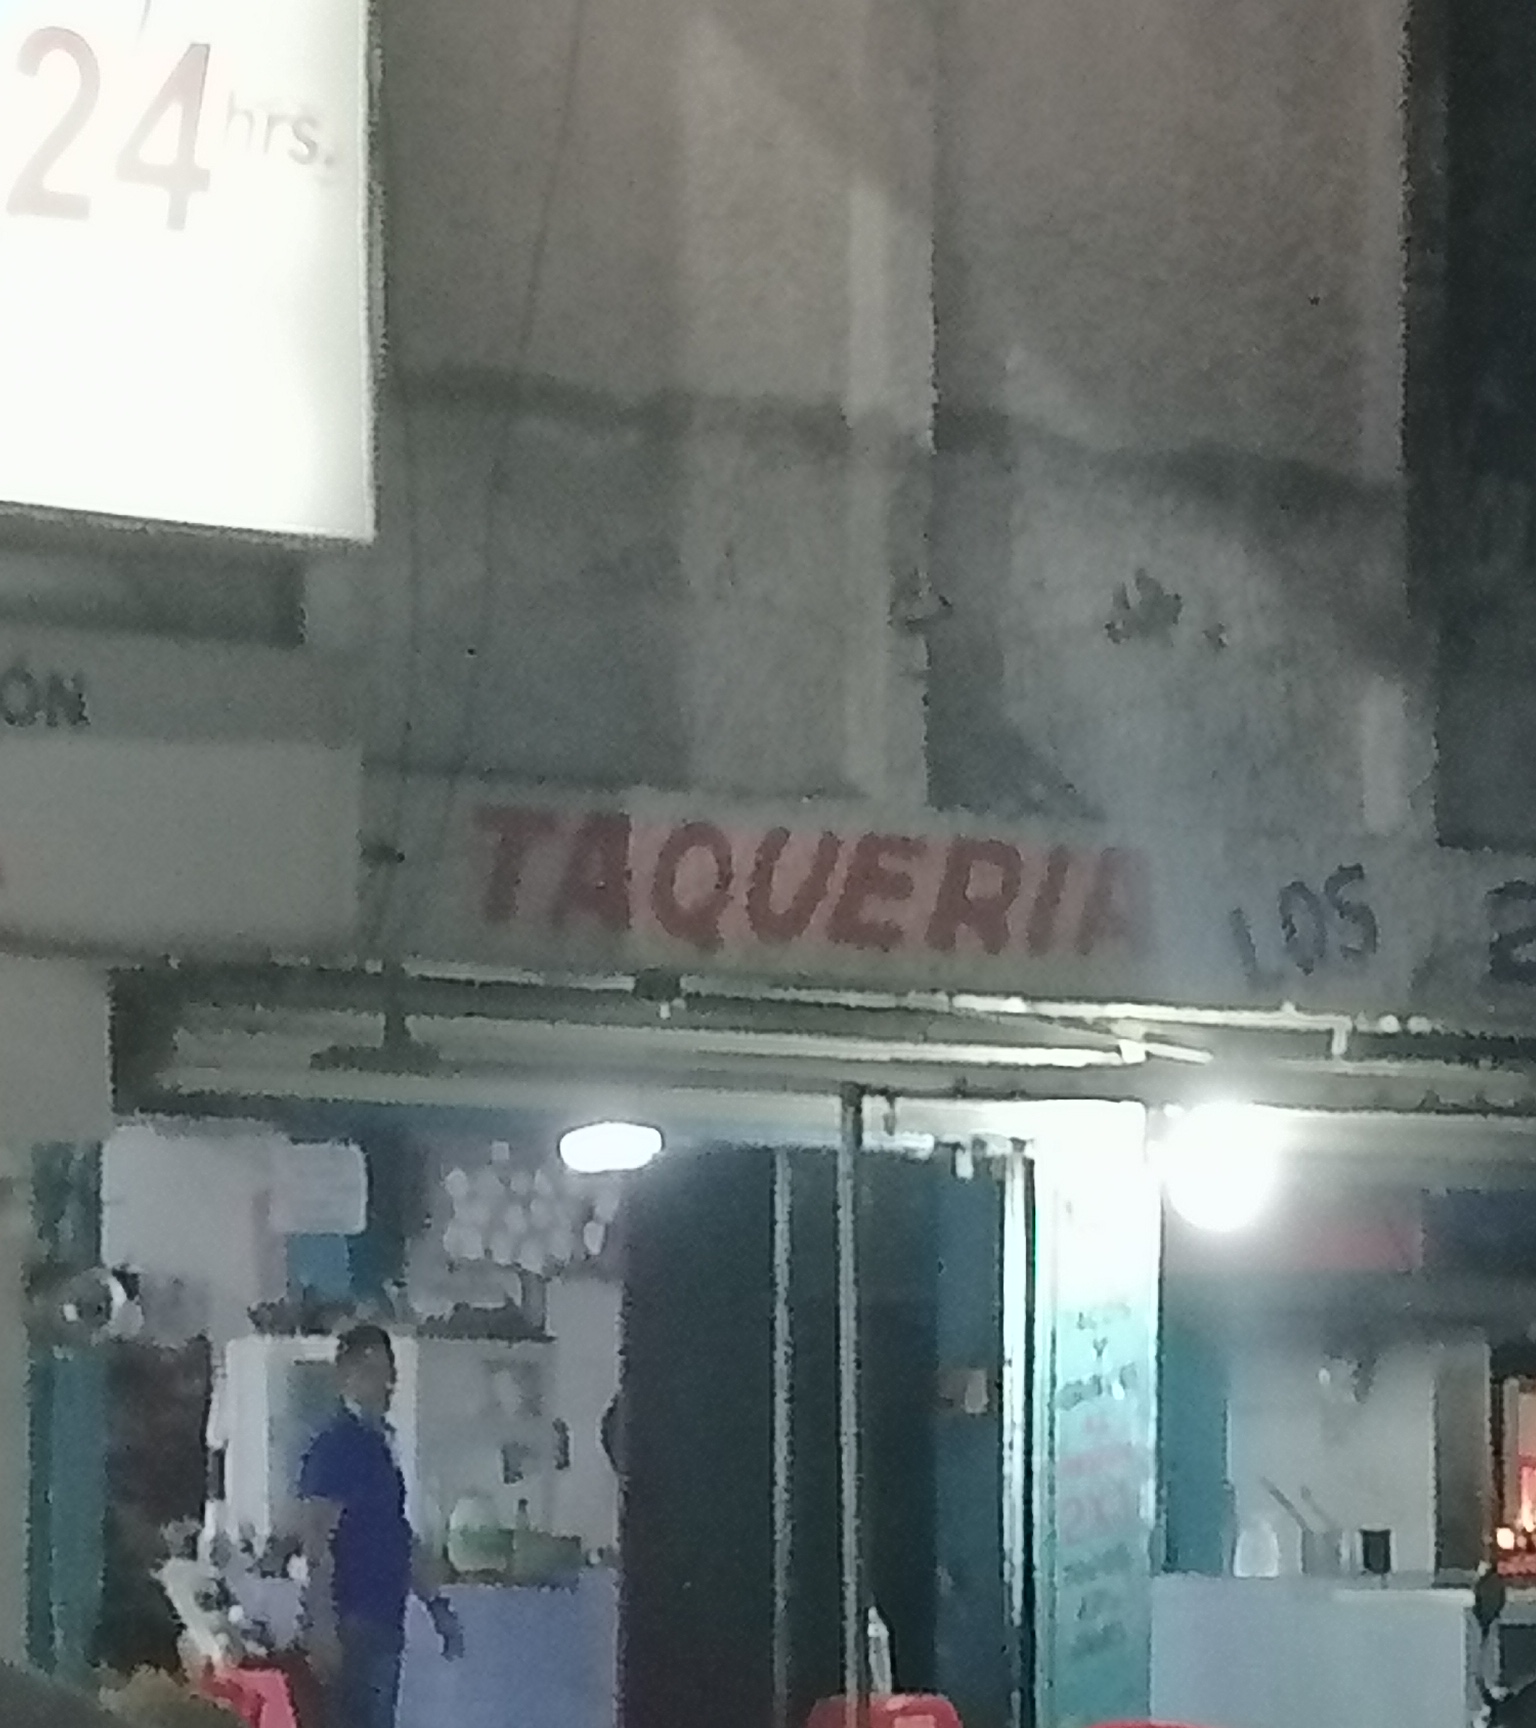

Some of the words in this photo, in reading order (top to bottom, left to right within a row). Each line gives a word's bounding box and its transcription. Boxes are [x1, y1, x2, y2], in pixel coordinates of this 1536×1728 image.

[5, 25, 211, 231] 24
[474, 804, 1154, 956] TAQUERIA
[1224, 862, 1381, 990] LOS
